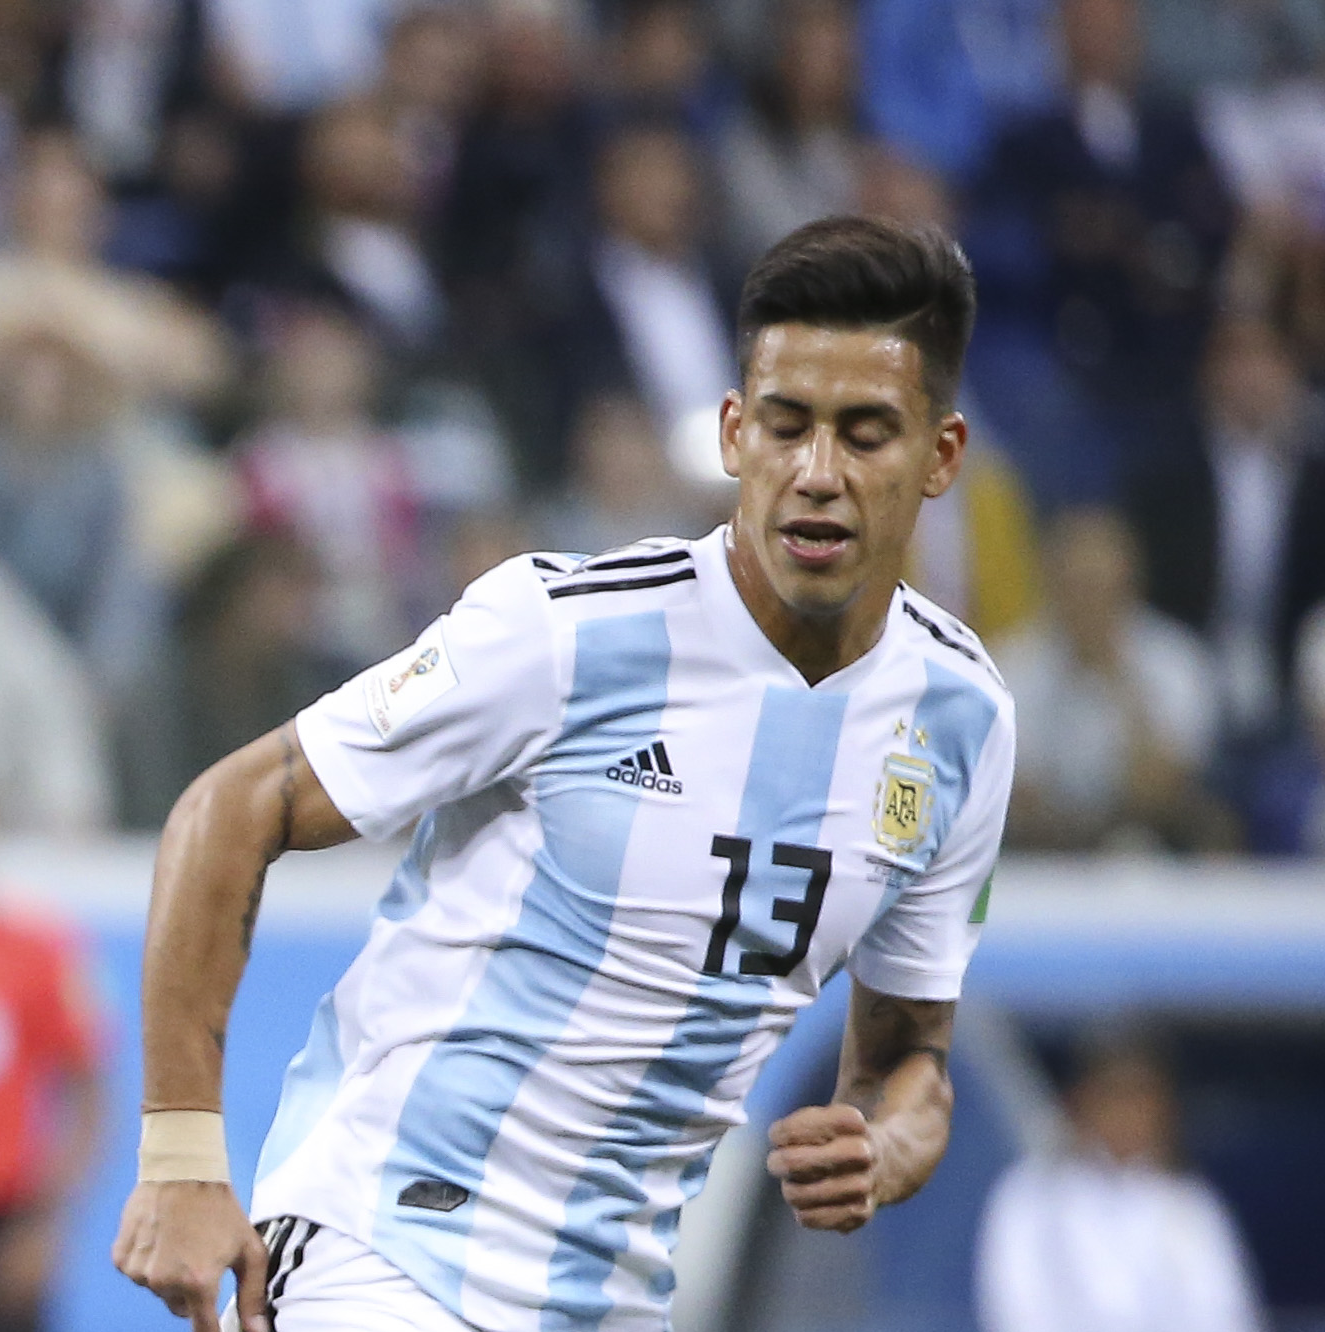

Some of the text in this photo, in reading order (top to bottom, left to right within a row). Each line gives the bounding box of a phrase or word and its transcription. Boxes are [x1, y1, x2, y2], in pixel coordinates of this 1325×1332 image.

[605, 763, 684, 796] adidas
[885, 778, 917, 828] AFA
[703, 833, 834, 976] 13
